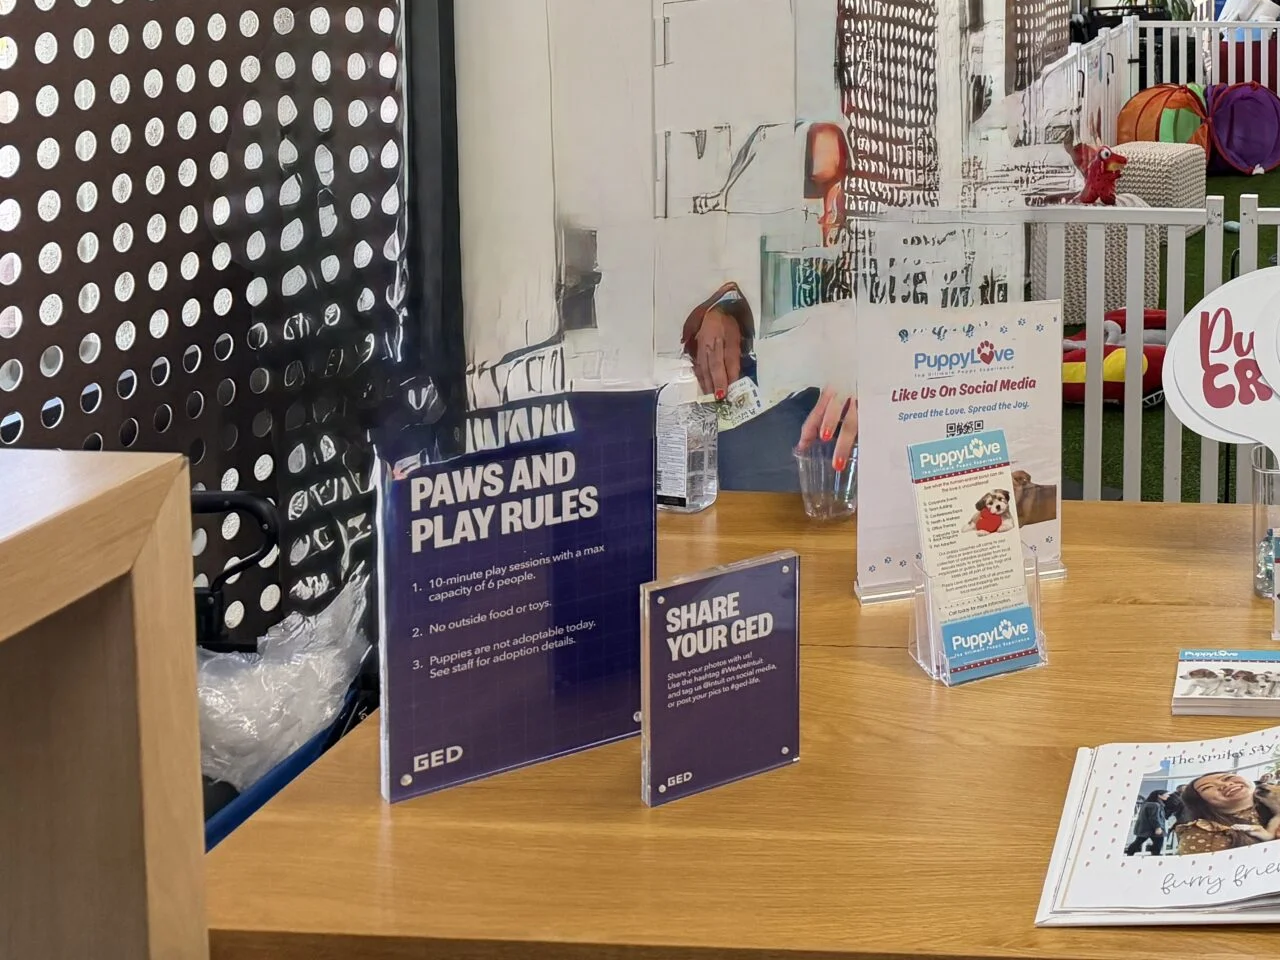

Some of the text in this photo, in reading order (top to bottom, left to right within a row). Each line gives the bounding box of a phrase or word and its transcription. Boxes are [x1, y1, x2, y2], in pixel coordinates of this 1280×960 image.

[891, 376, 1036, 402] Like Us On Social Media
[898, 409, 928, 422] Spread
[930, 408, 943, 417] the
[968, 403, 997, 414] Spread
[998, 401, 1011, 410] the
[1013, 400, 1029, 409] Joy.
[411, 450, 576, 512] PAWS AND
[411, 485, 599, 553] PLAY RULES
[412, 544, 605, 592] 1. 10-minute play sessions with a max
[428, 572, 536, 603] capacity of 6 people.
[412, 599, 551, 638] 2. No outside food or toys.
[666, 591, 740, 633] SHARE
[412, 619, 596, 670] 3. Puppies are not adoptable today.
[666, 612, 774, 662] YOUR GED
[429, 637, 576, 679] See staff for adoption details.
[667, 671, 687, 681] Share
[688, 666, 703, 676] your
[703, 660, 727, 672] photos
[728, 655, 742, 664] with
[668, 682, 680, 690] Use
[681, 678, 692, 686] the
[694, 670, 720, 682] hashtag
[668, 690, 680, 699] and
[681, 687, 693, 696] tag
[726, 675, 735, 683] on
[736, 669, 754, 680] social
[676, 696, 691, 707] post
[692, 692, 707, 703] your
[708, 688, 722, 698] pics
[413, 745, 464, 772] GED
[1171, 754, 1194, 765] The
[1249, 743, 1274, 756] say
[667, 771, 693, 787] GED
[1161, 872, 1225, 895] furry
